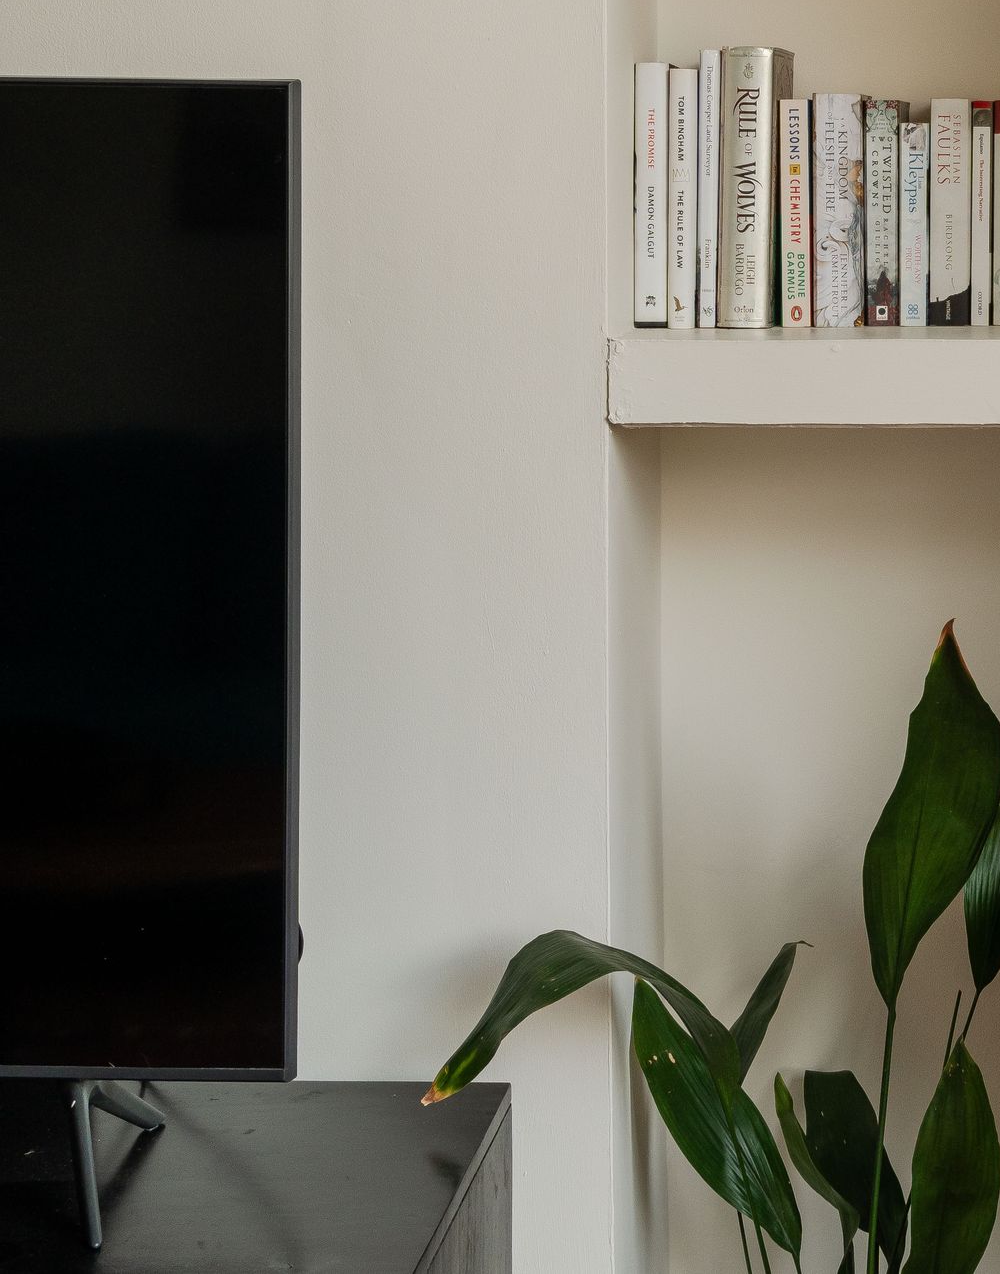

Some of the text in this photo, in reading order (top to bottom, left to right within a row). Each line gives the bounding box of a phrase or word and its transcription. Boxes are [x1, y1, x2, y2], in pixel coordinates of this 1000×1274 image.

[705, 94, 713, 122] Cowper
[677, 119, 685, 161] BINGHAM
[789, 108, 800, 160] LESSONS
[825, 121, 835, 162] FLESH
[937, 115, 951, 185] FAULKS
[953, 114, 962, 184] SEBASTIAN
[704, 144, 712, 176] Surveyor
[733, 86, 763, 233] RULE OF WOLVES
[838, 130, 849, 201] KINGDOM
[882, 143, 892, 214] TWISTED
[903, 152, 924, 213] Kleypas
[790, 179, 801, 244] CHEMISTRY
[825, 183, 836, 213] FIRE
[676, 235, 684, 246] OF
[704, 239, 712, 268] Franklin
[905, 247, 913, 271] PRICE
[945, 214, 953, 271] BIRDSONG
[735, 243, 745, 296] BARDUGO
[746, 254, 755, 285] LEIGH
[787, 252, 795, 300] GARMUS
[797, 253, 806, 298] BONNIE
[831, 247, 841, 320] ARMENTROUT
[839, 253, 848, 300] JENNIFER
[734, 305, 754, 314] Orion
